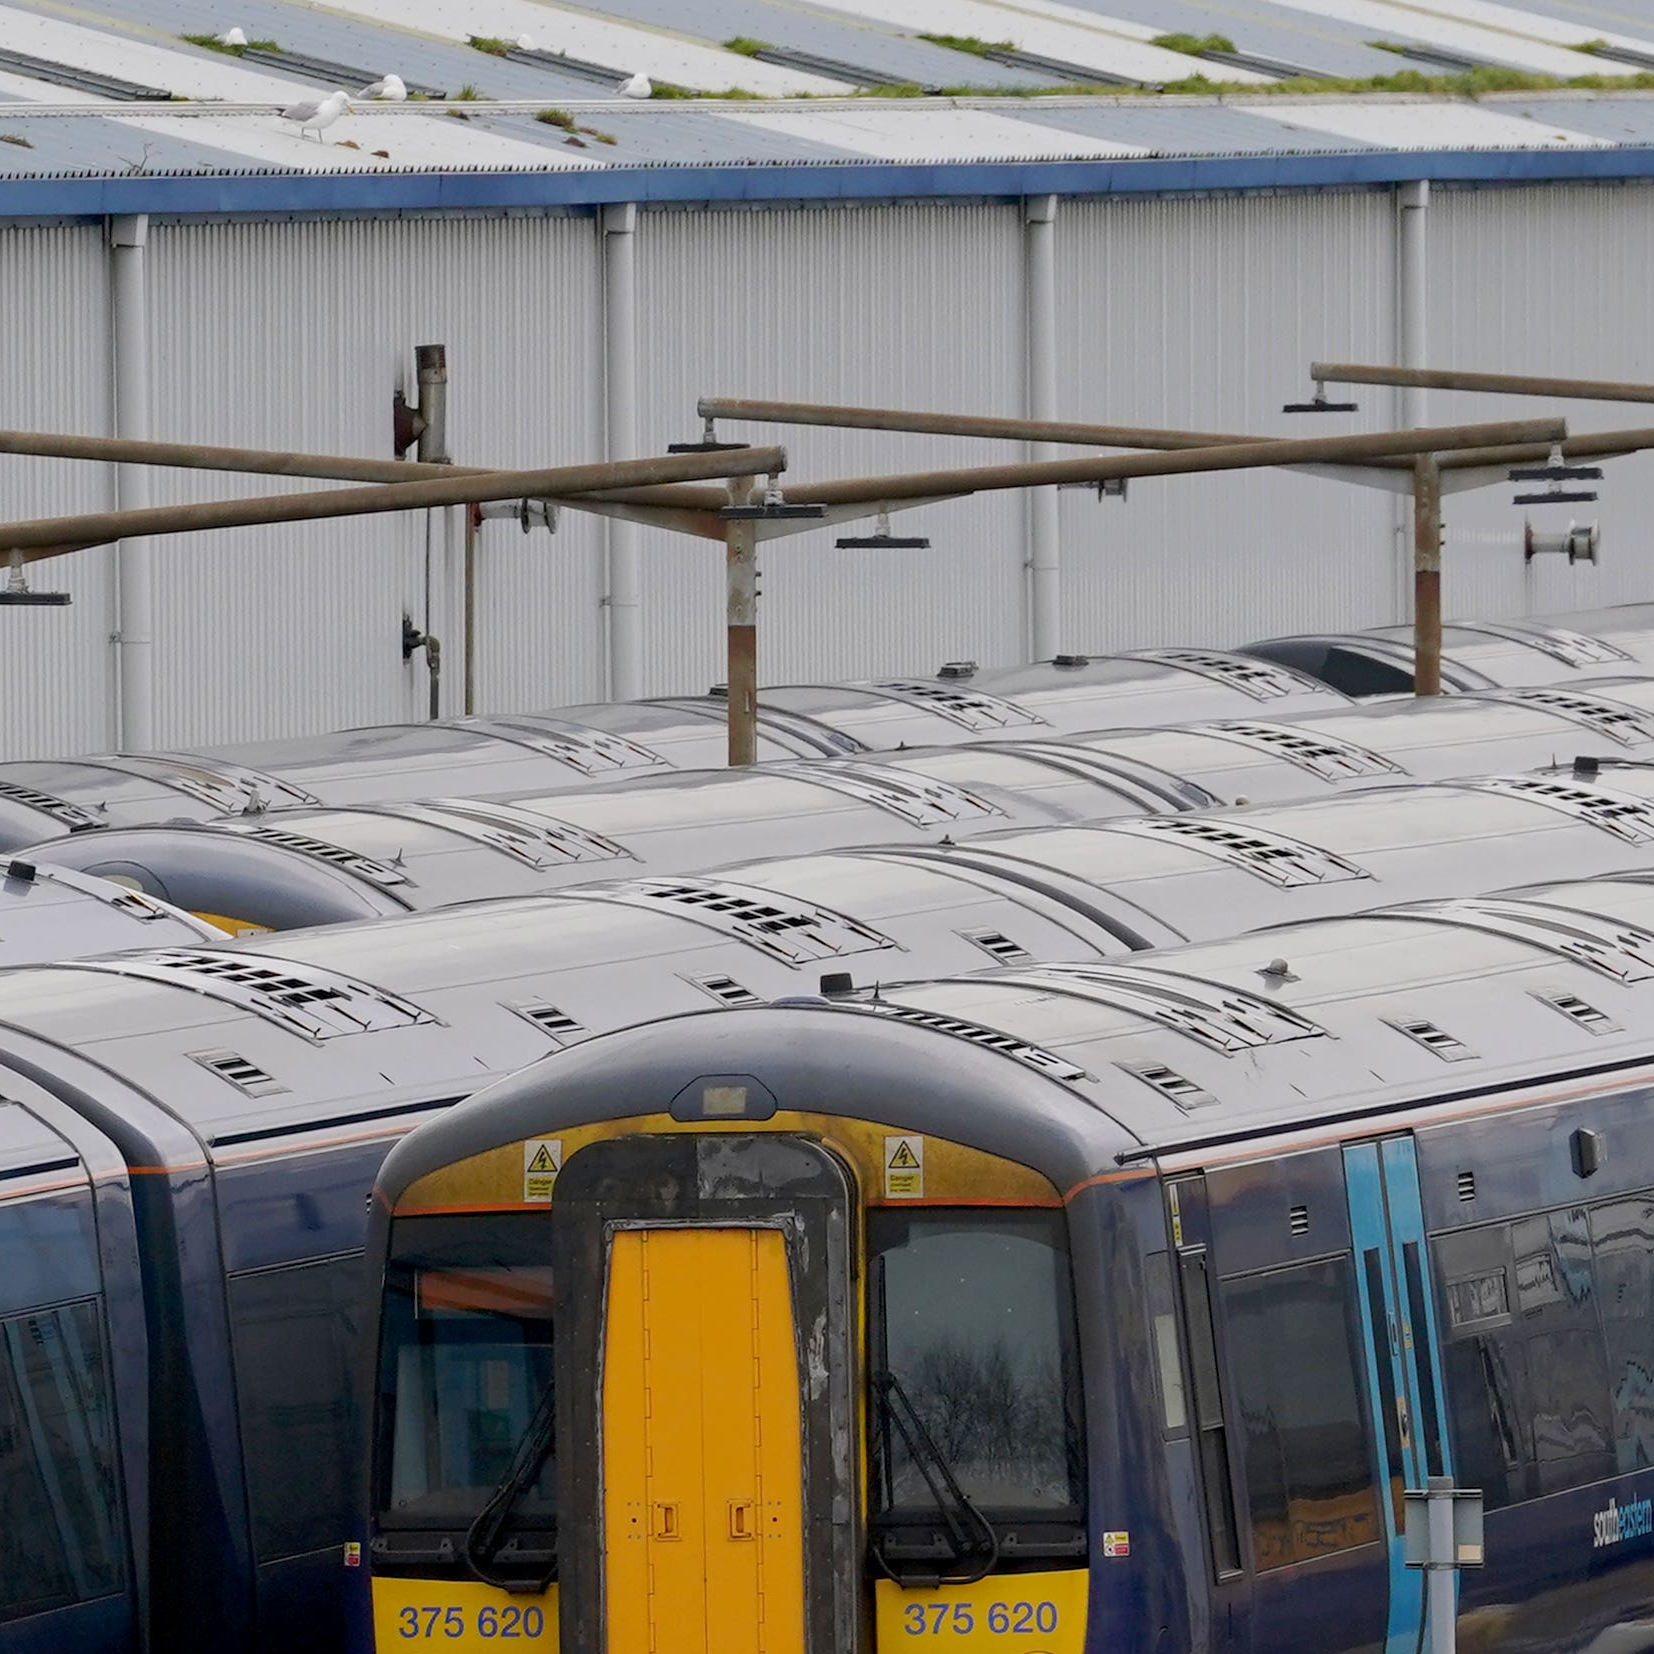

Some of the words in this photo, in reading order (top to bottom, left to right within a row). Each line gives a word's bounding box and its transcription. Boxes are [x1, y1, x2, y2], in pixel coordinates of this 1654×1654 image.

[399, 1606, 465, 1638] 375
[478, 1605, 544, 1638] 620
[904, 1603, 975, 1636] 375
[988, 1601, 1058, 1634] 620
